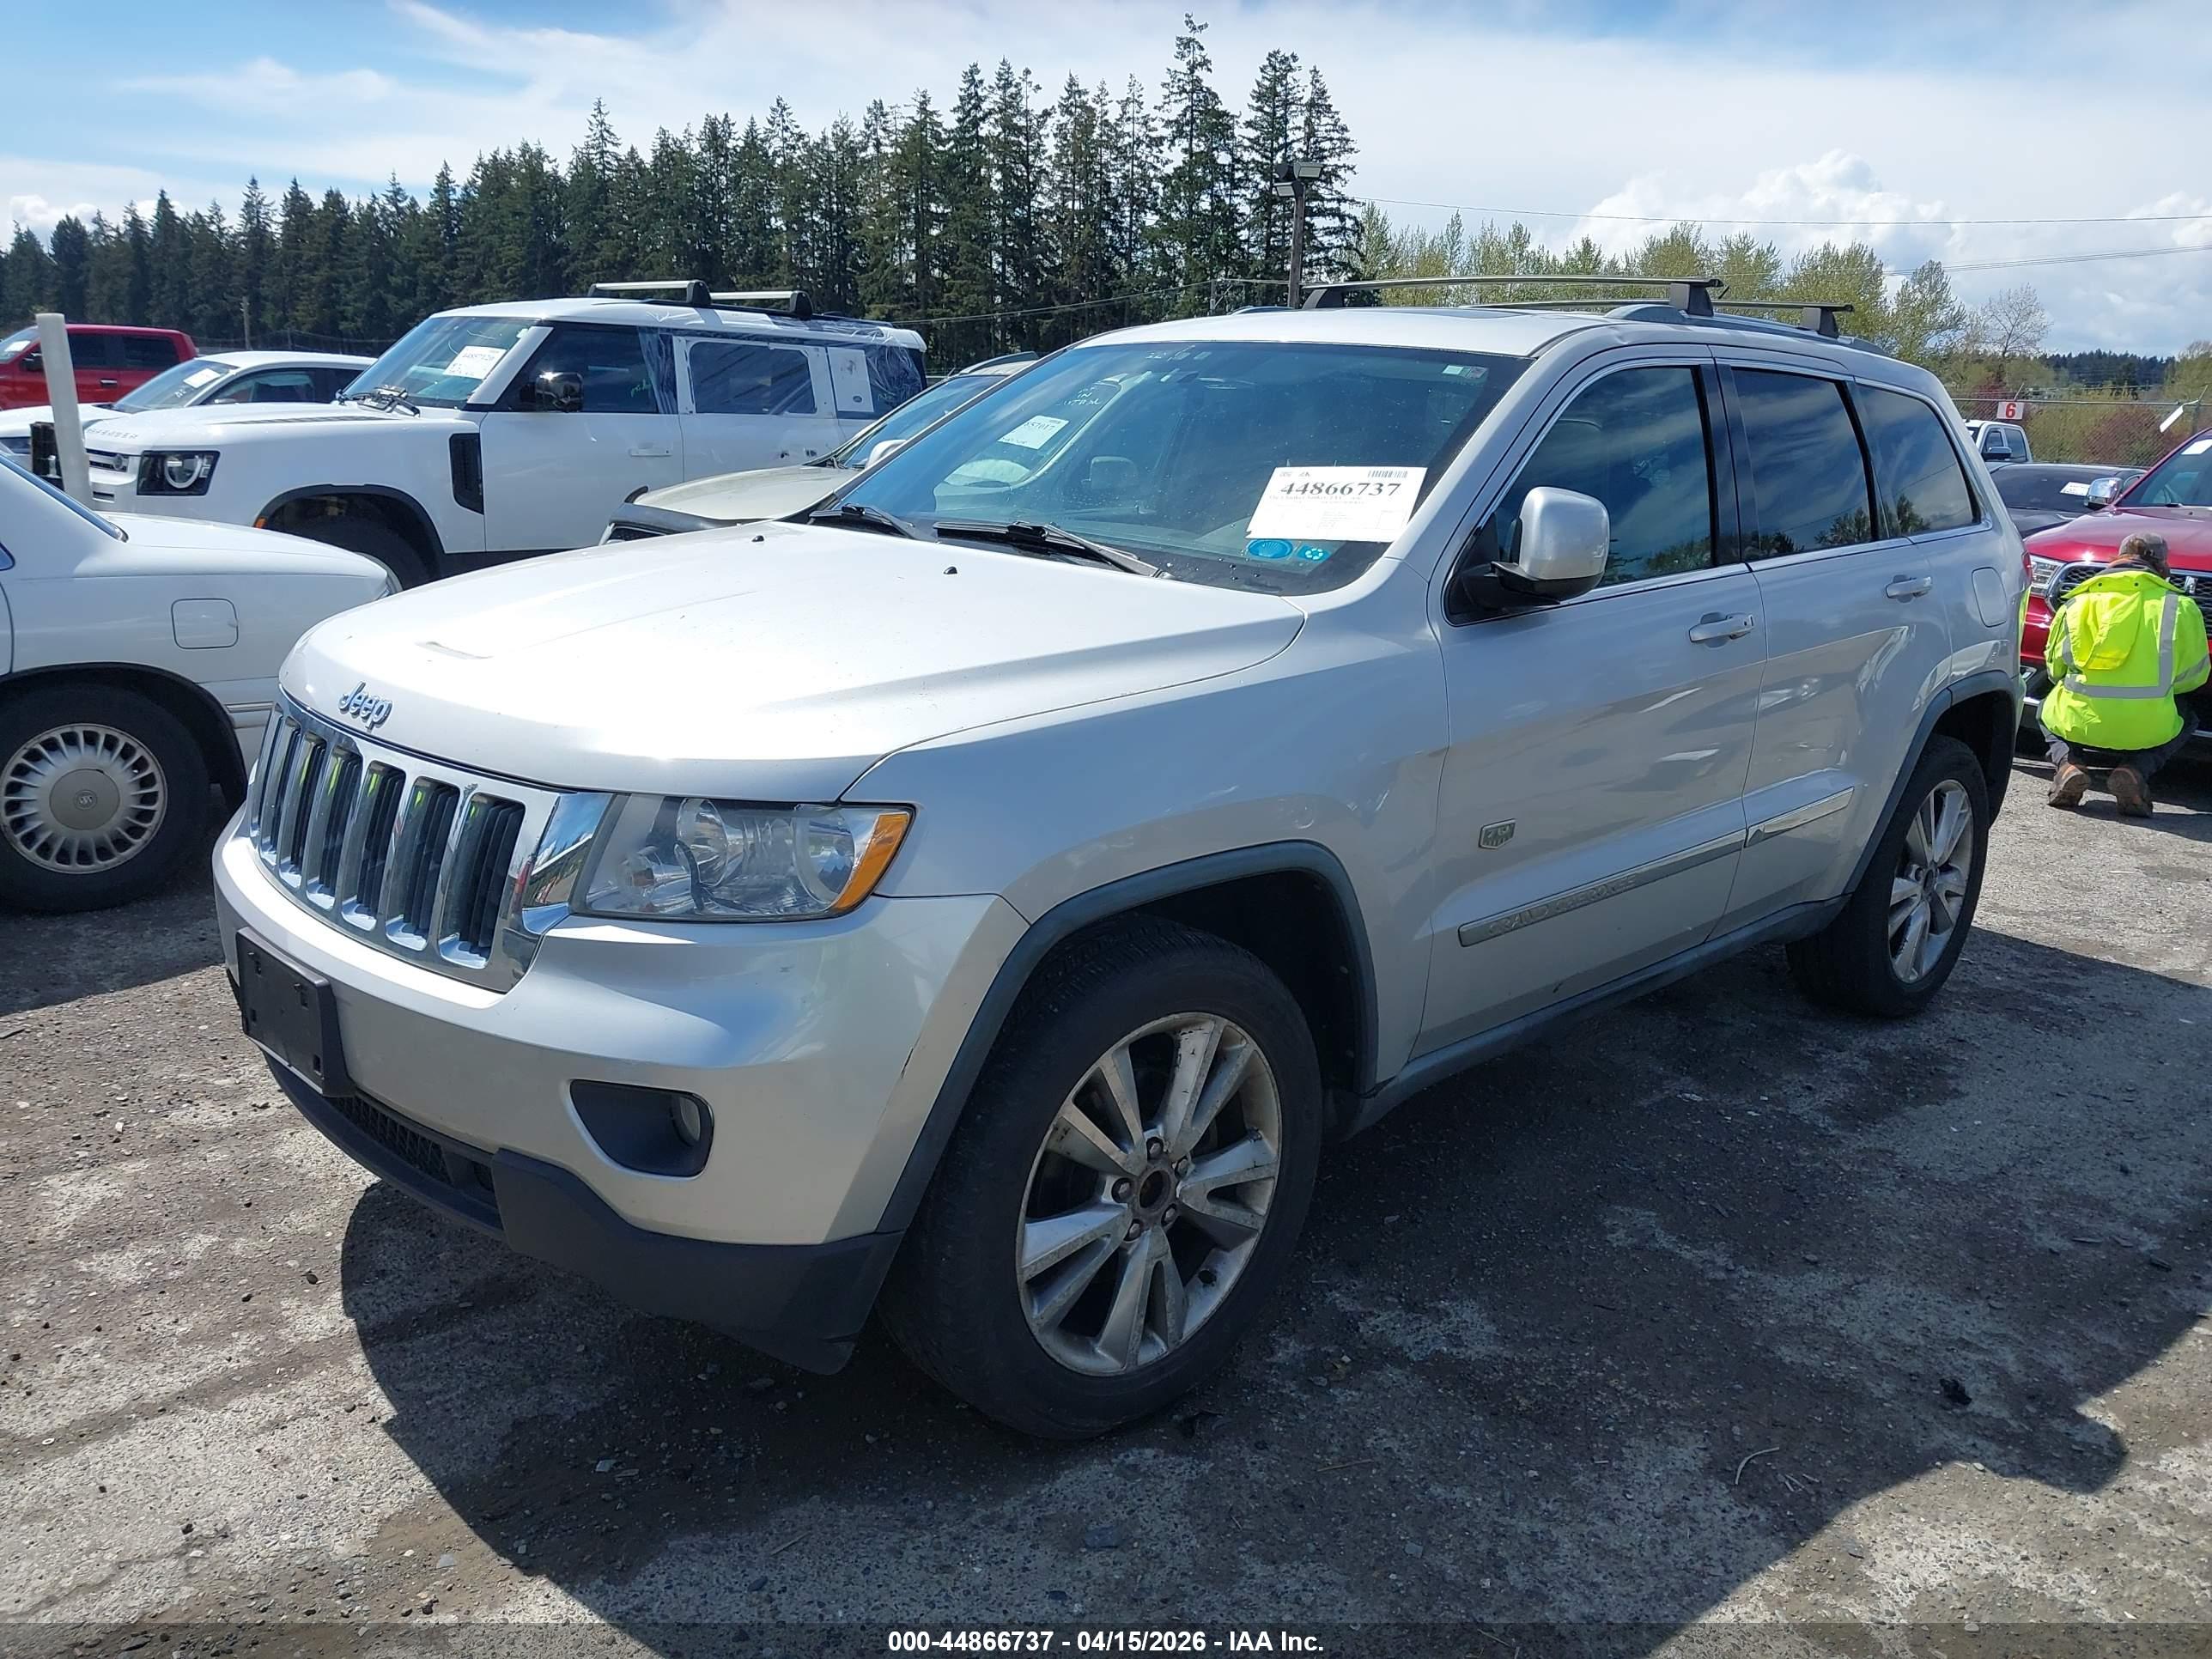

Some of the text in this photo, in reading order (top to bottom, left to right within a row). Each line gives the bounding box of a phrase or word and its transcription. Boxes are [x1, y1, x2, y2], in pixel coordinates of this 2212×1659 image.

[2005, 402, 2016, 418] 6
[1280, 482, 1401, 496] 44866737
[338, 680, 393, 732] Jeep
